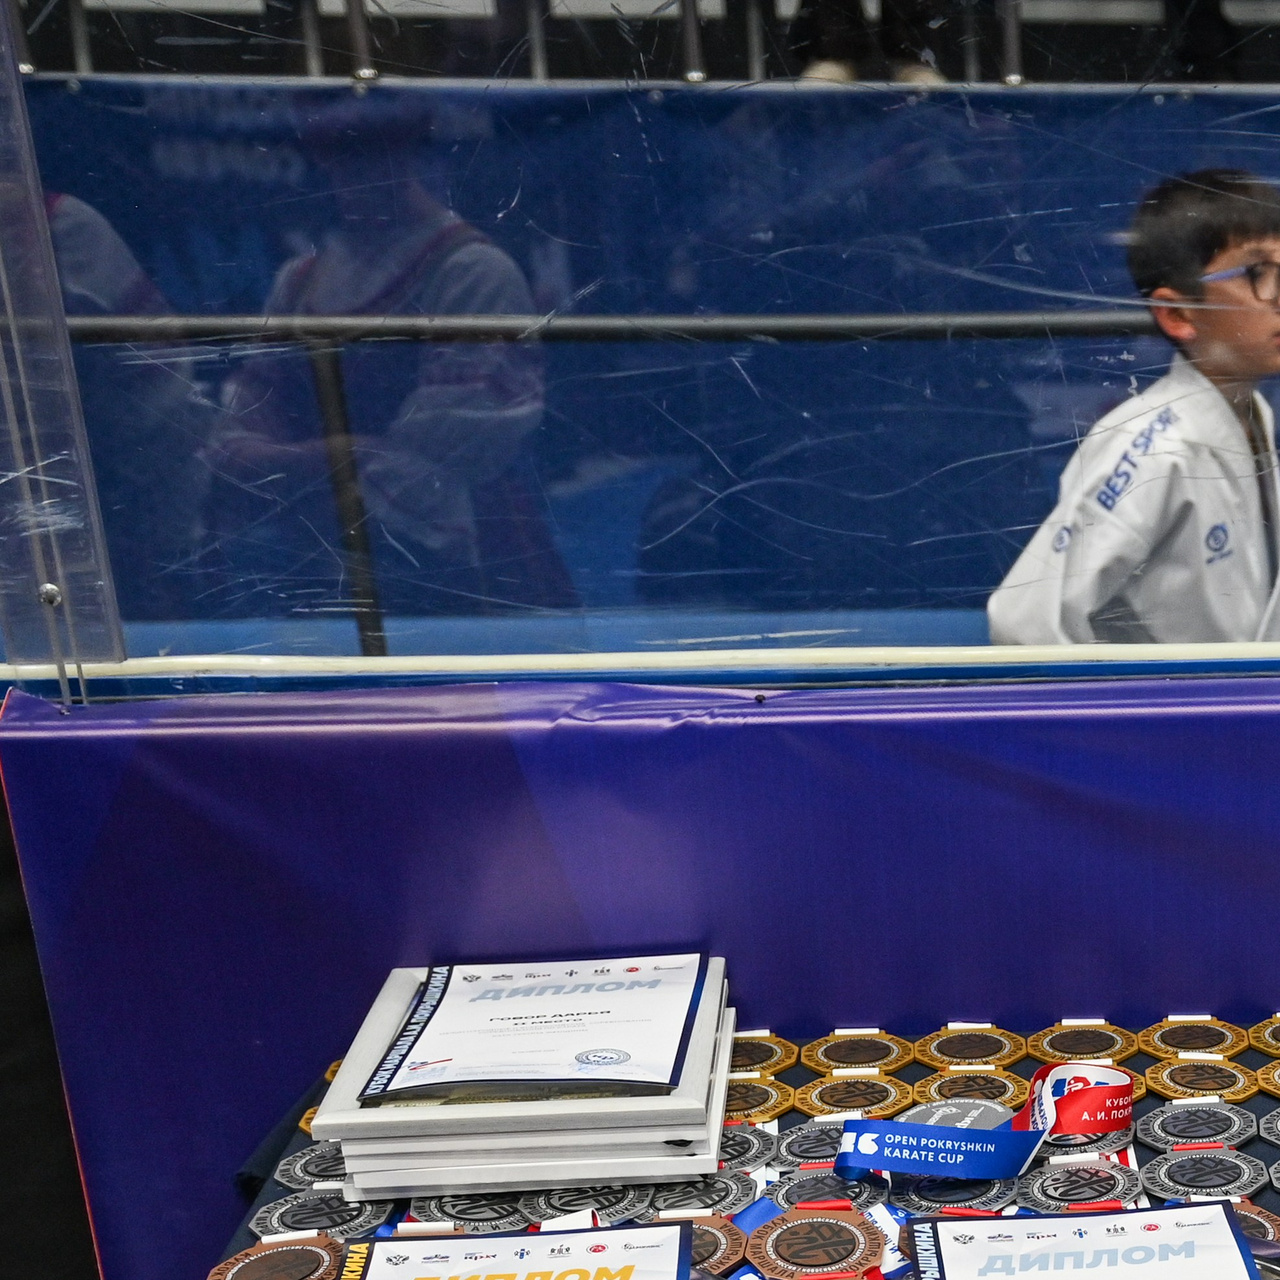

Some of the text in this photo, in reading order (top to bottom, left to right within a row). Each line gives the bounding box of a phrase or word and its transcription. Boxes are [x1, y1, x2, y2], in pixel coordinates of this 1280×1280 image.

[1096, 451, 1137, 510] BEST
[468, 979, 662, 1002] ДИПЛОМ
[490, 1010, 611, 1022] ГОВОР ДАРЬЯ
[885, 1135, 995, 1152] OPEN POKRYSHKIN
[883, 1149, 964, 1164] KARATE CUP
[978, 1241, 1195, 1277] ДИПЛОМ
